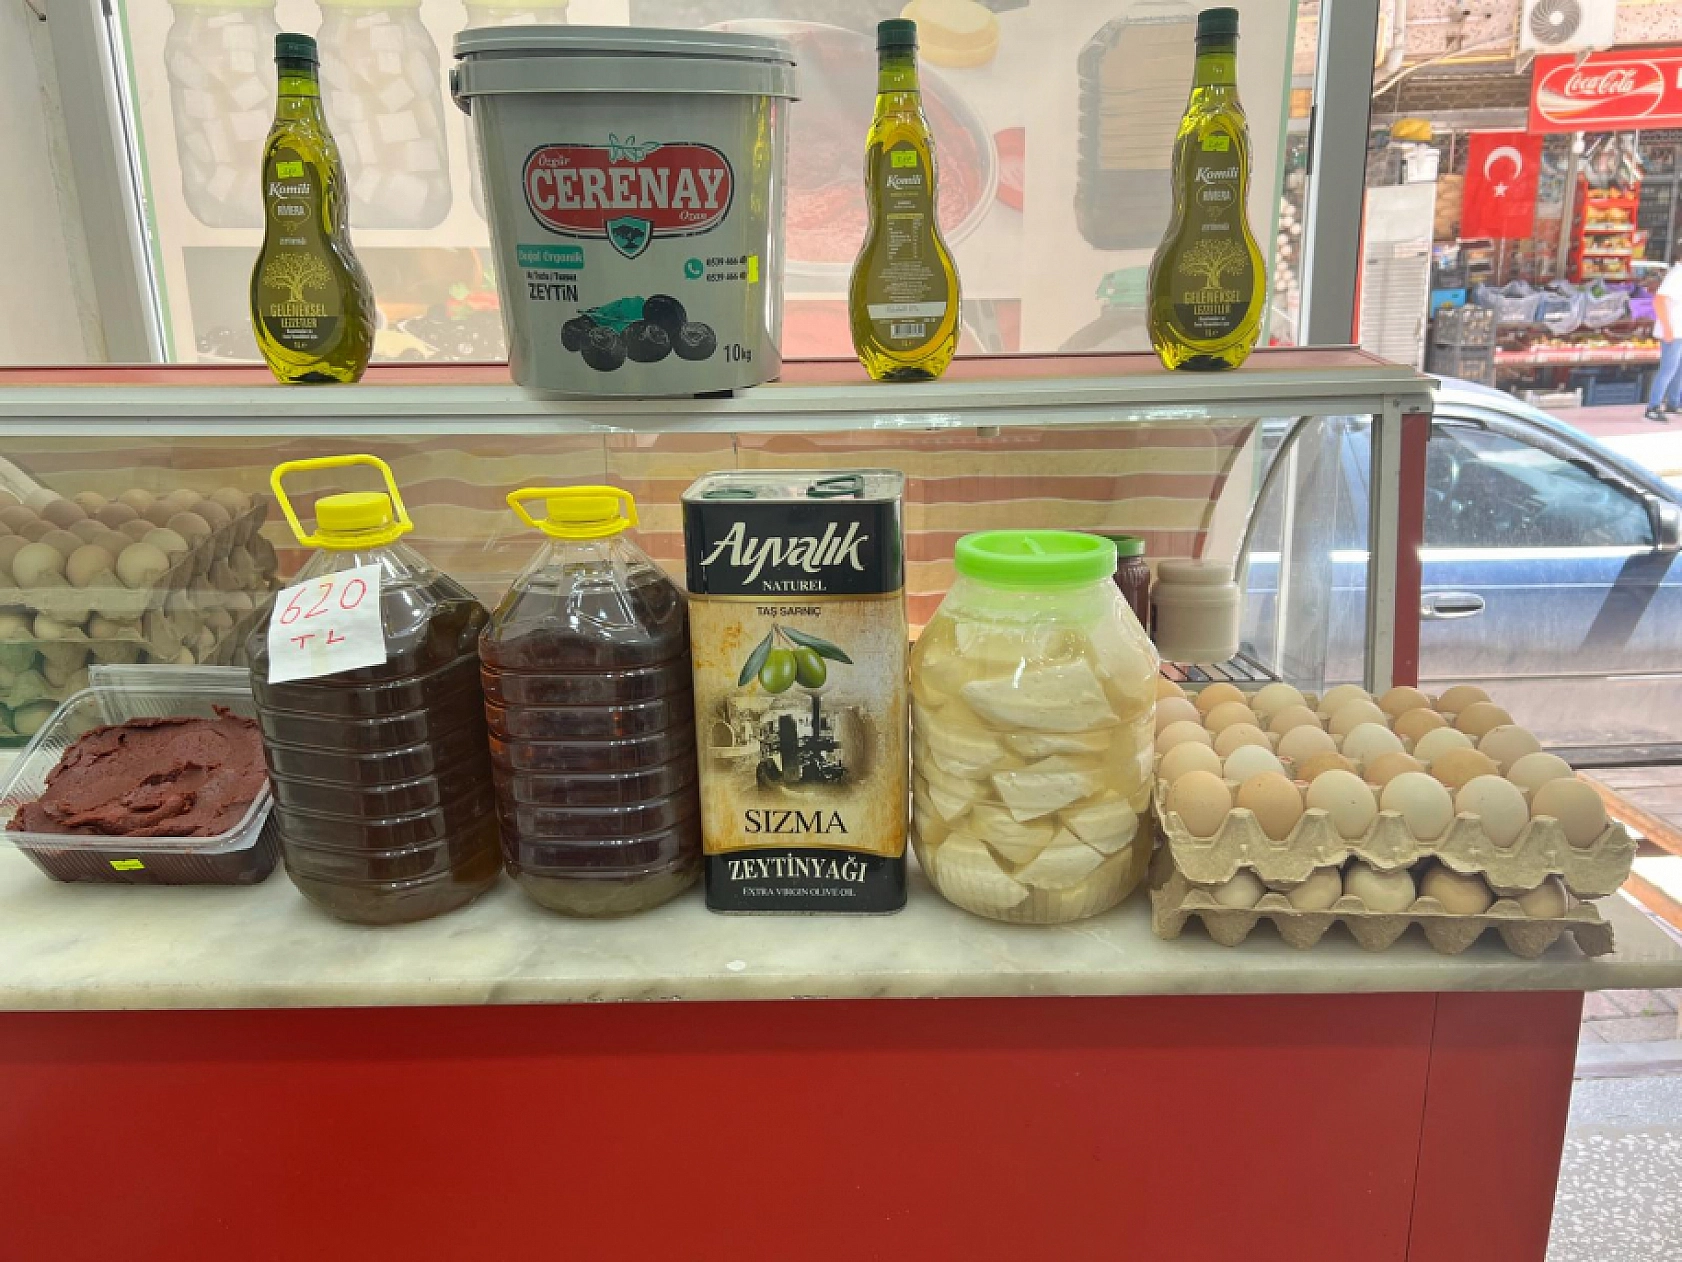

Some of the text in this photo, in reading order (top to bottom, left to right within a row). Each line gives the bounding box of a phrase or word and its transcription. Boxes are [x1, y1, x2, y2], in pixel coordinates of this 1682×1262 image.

[886, 174, 922, 190] Komili
[1194, 166, 1239, 184] Komili
[269, 181, 311, 199] Komili
[531, 167, 725, 209] CERENAY
[699, 521, 870, 586] Ayvalık
[762, 580, 827, 592] NATUREL
[279, 578, 367, 625] 620
[756, 606, 777, 618] TAŞ
[744, 809, 848, 834] SIZMA
[728, 852, 869, 884] ZEYTİNYAĞI
[742, 886, 775, 897] EXTRA
